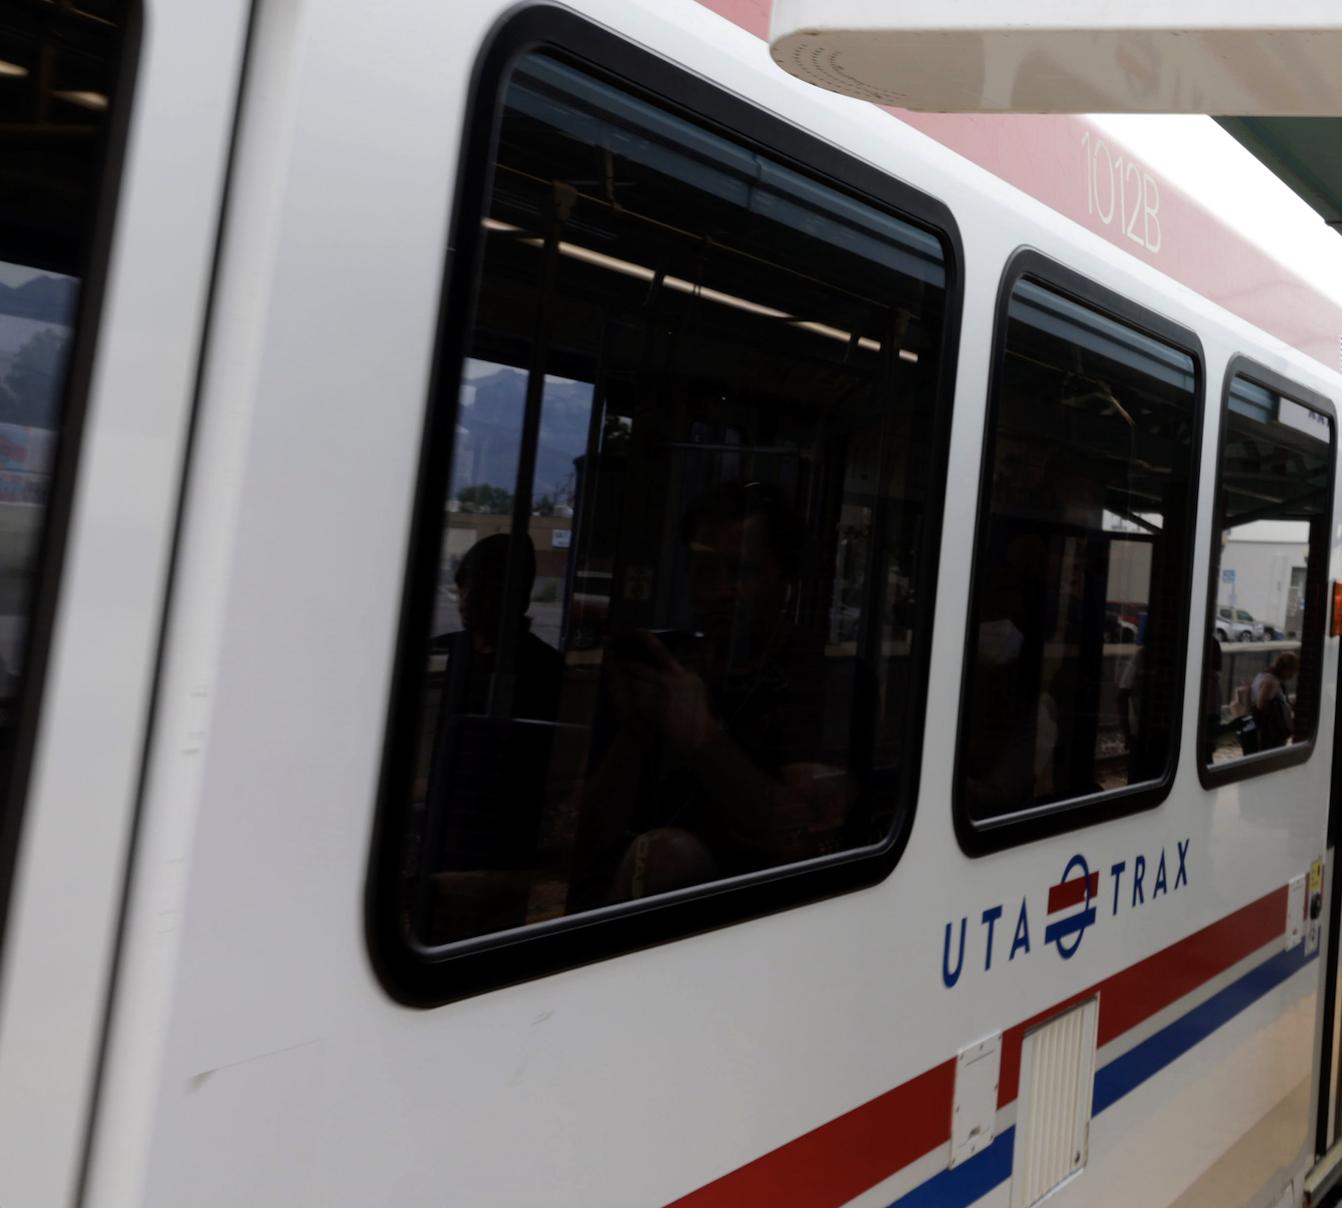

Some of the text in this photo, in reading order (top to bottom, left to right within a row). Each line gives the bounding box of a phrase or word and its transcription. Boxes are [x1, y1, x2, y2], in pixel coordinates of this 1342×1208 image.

[1081, 131, 1161, 253] 1012B
[942, 838, 1190, 988] UTA TRAX
